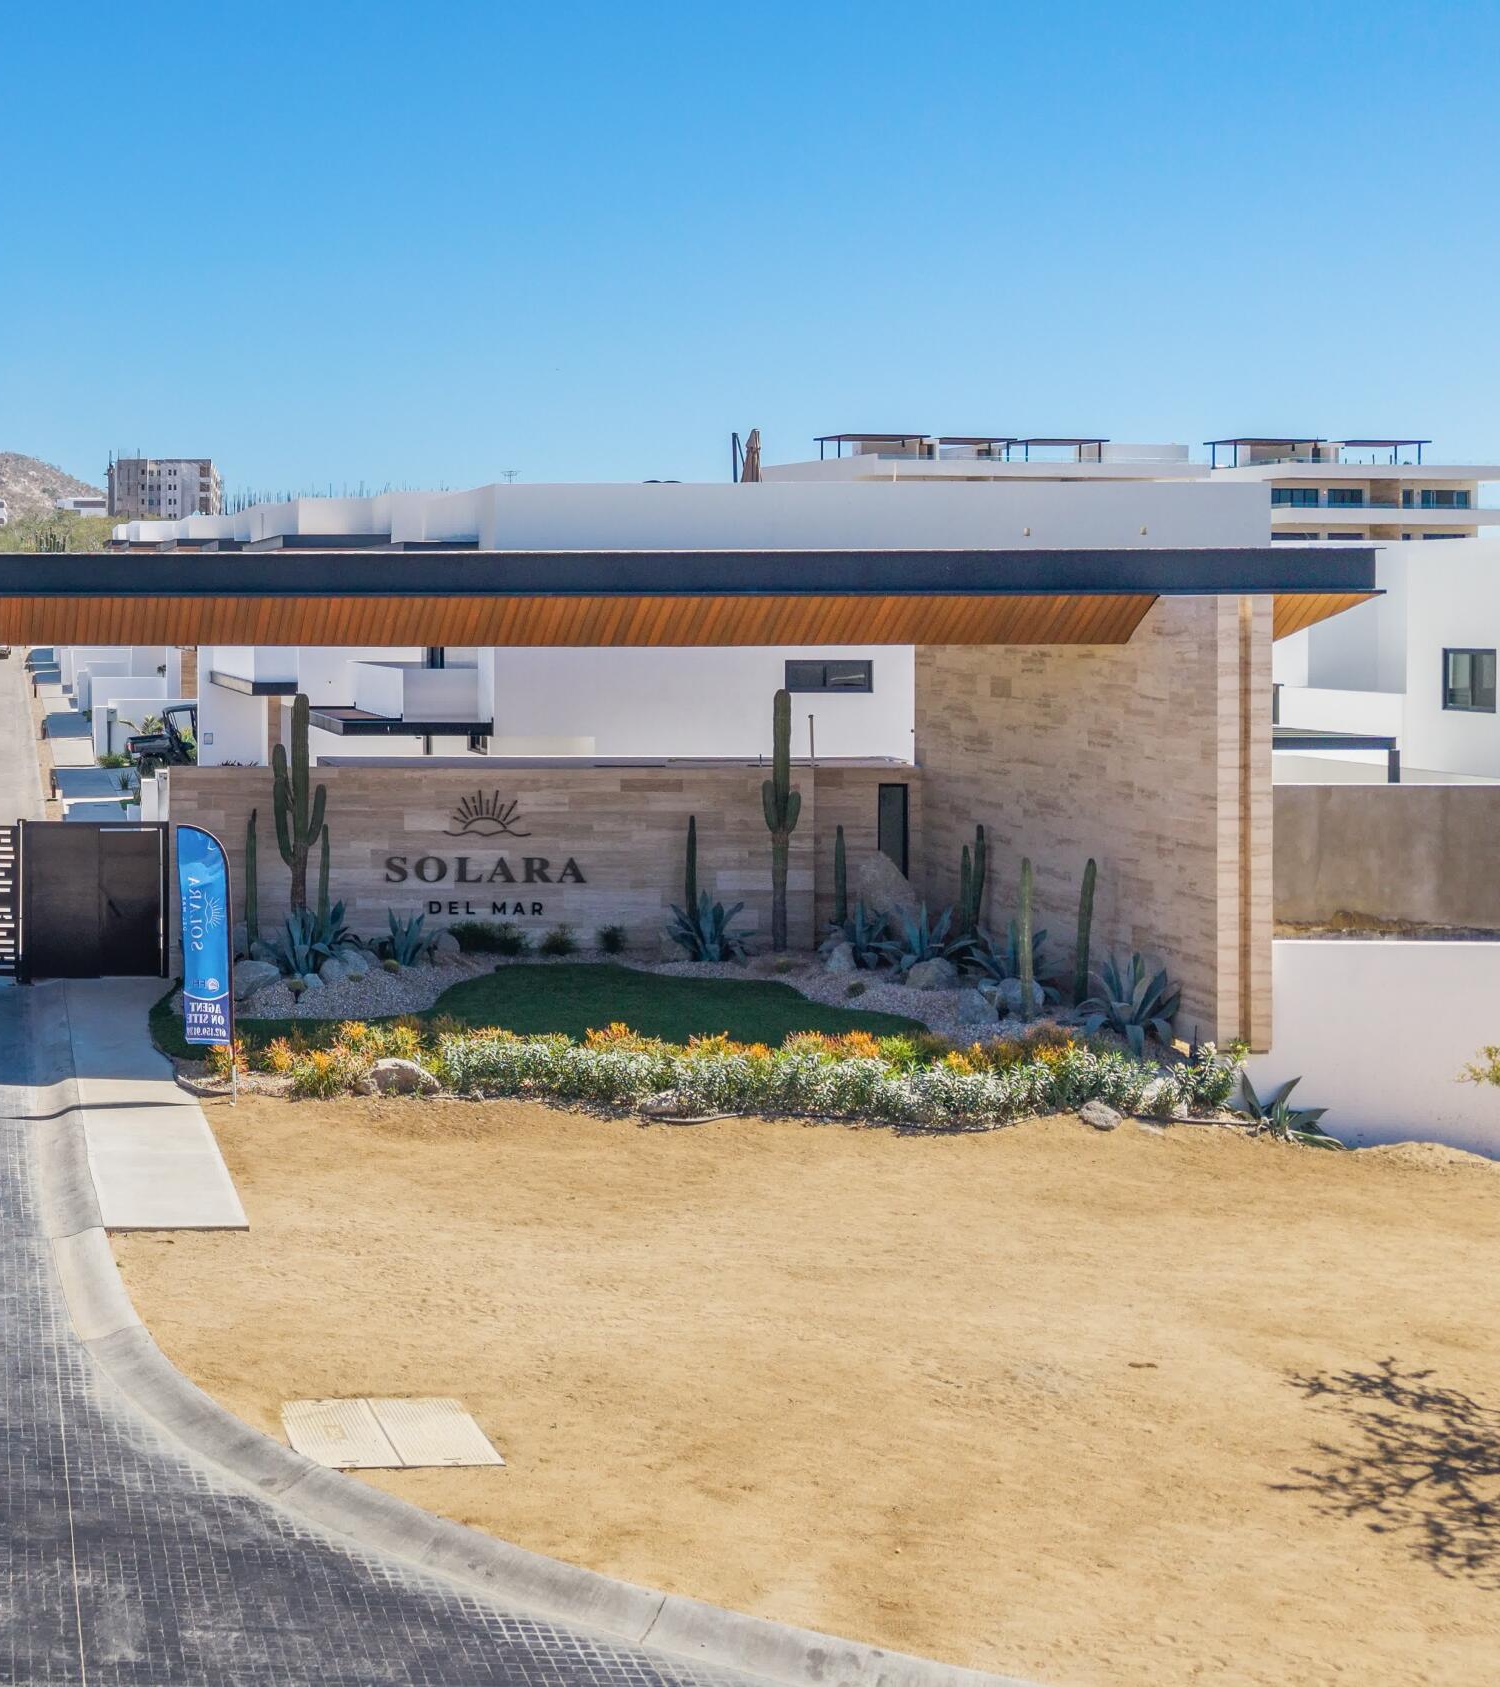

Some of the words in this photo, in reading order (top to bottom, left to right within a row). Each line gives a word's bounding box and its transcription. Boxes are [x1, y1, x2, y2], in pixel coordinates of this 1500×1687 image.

[385, 856, 587, 884] SOLARA
[429, 901, 476, 915] DEL
[492, 901, 543, 916] MAR
